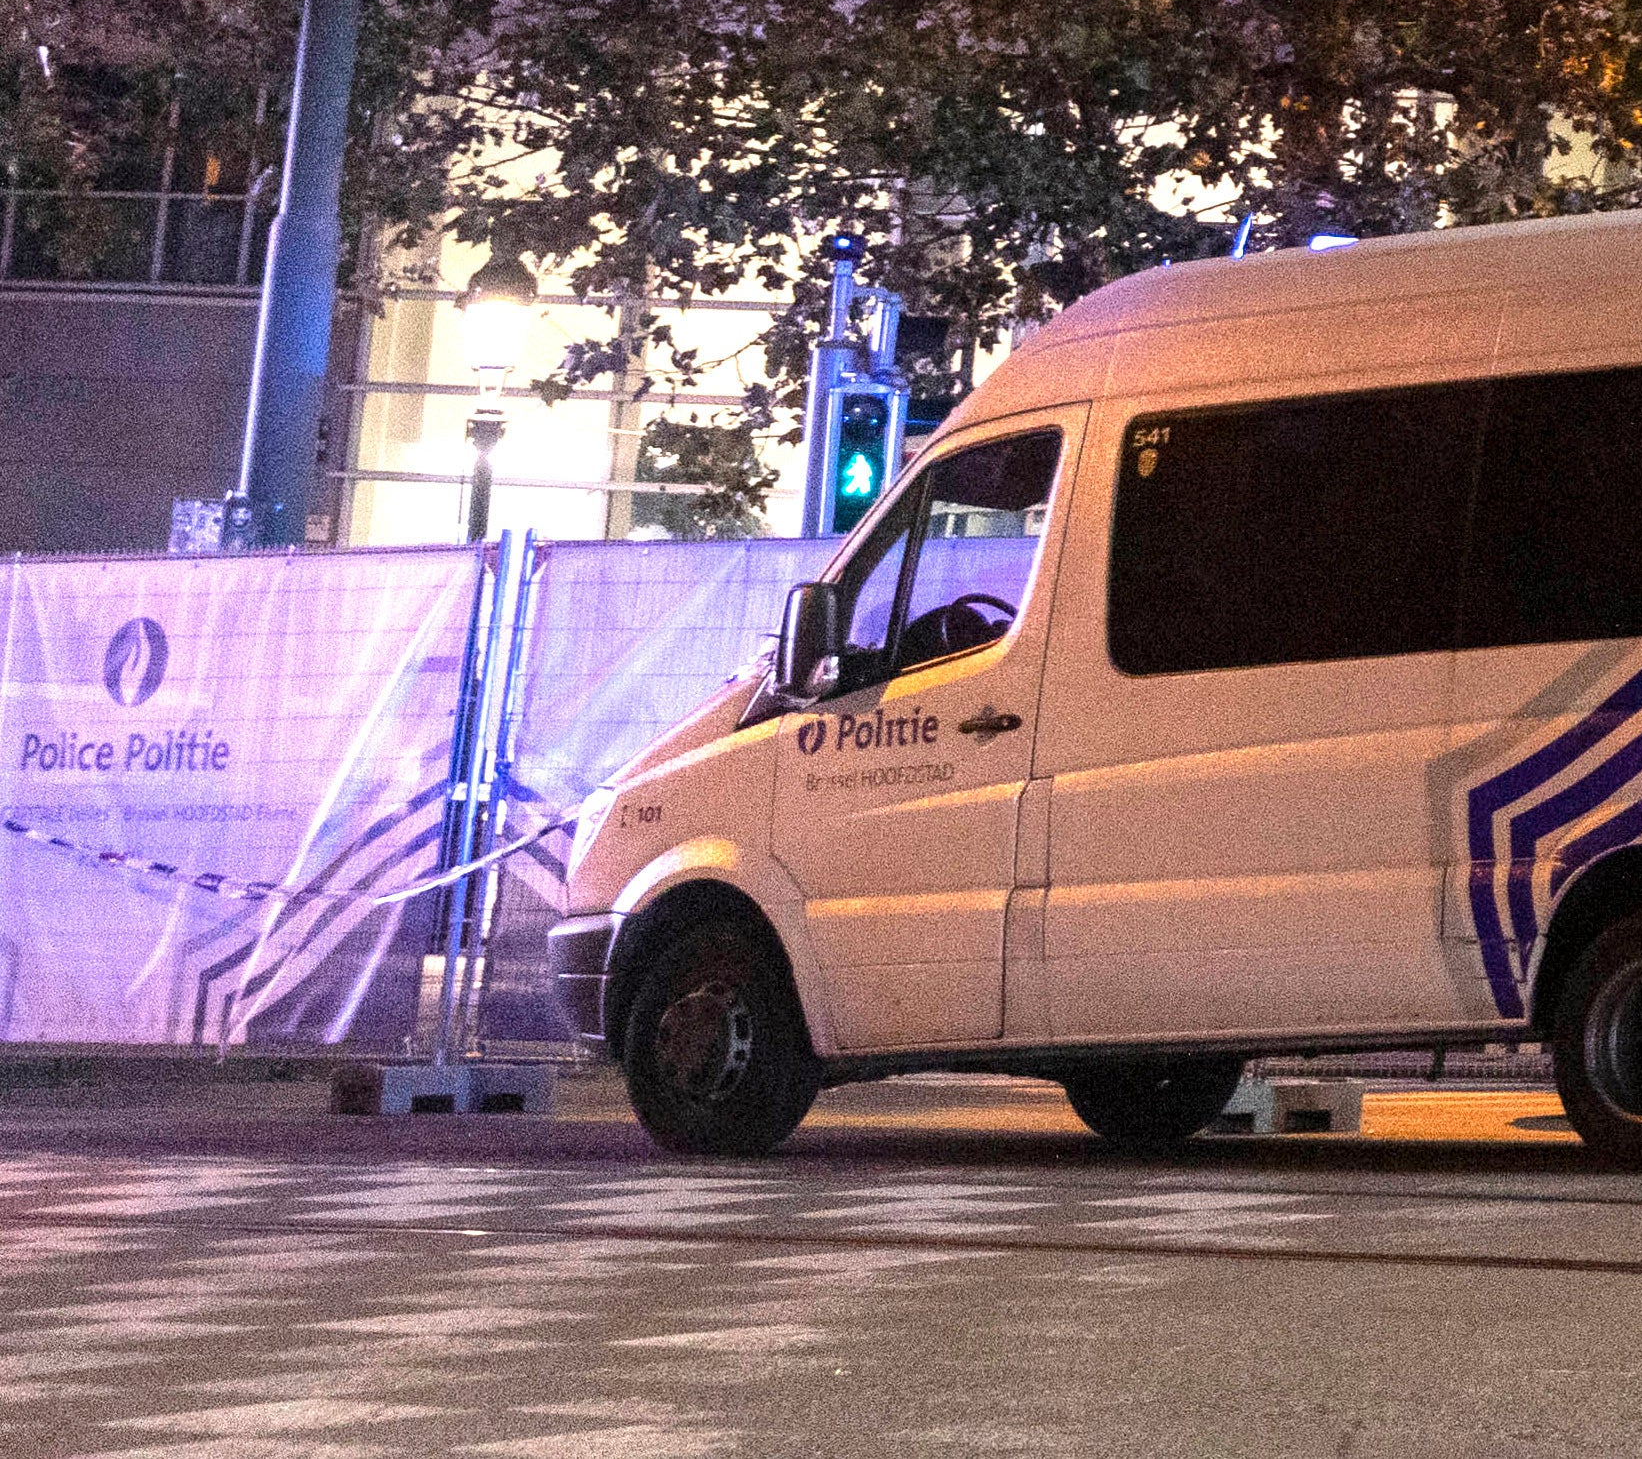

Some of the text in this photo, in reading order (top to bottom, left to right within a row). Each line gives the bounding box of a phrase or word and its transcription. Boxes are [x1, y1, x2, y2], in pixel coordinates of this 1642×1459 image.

[836, 706, 940, 751] Politie
[20, 730, 230, 771] Police Politie
[638, 804, 662, 824] 101
